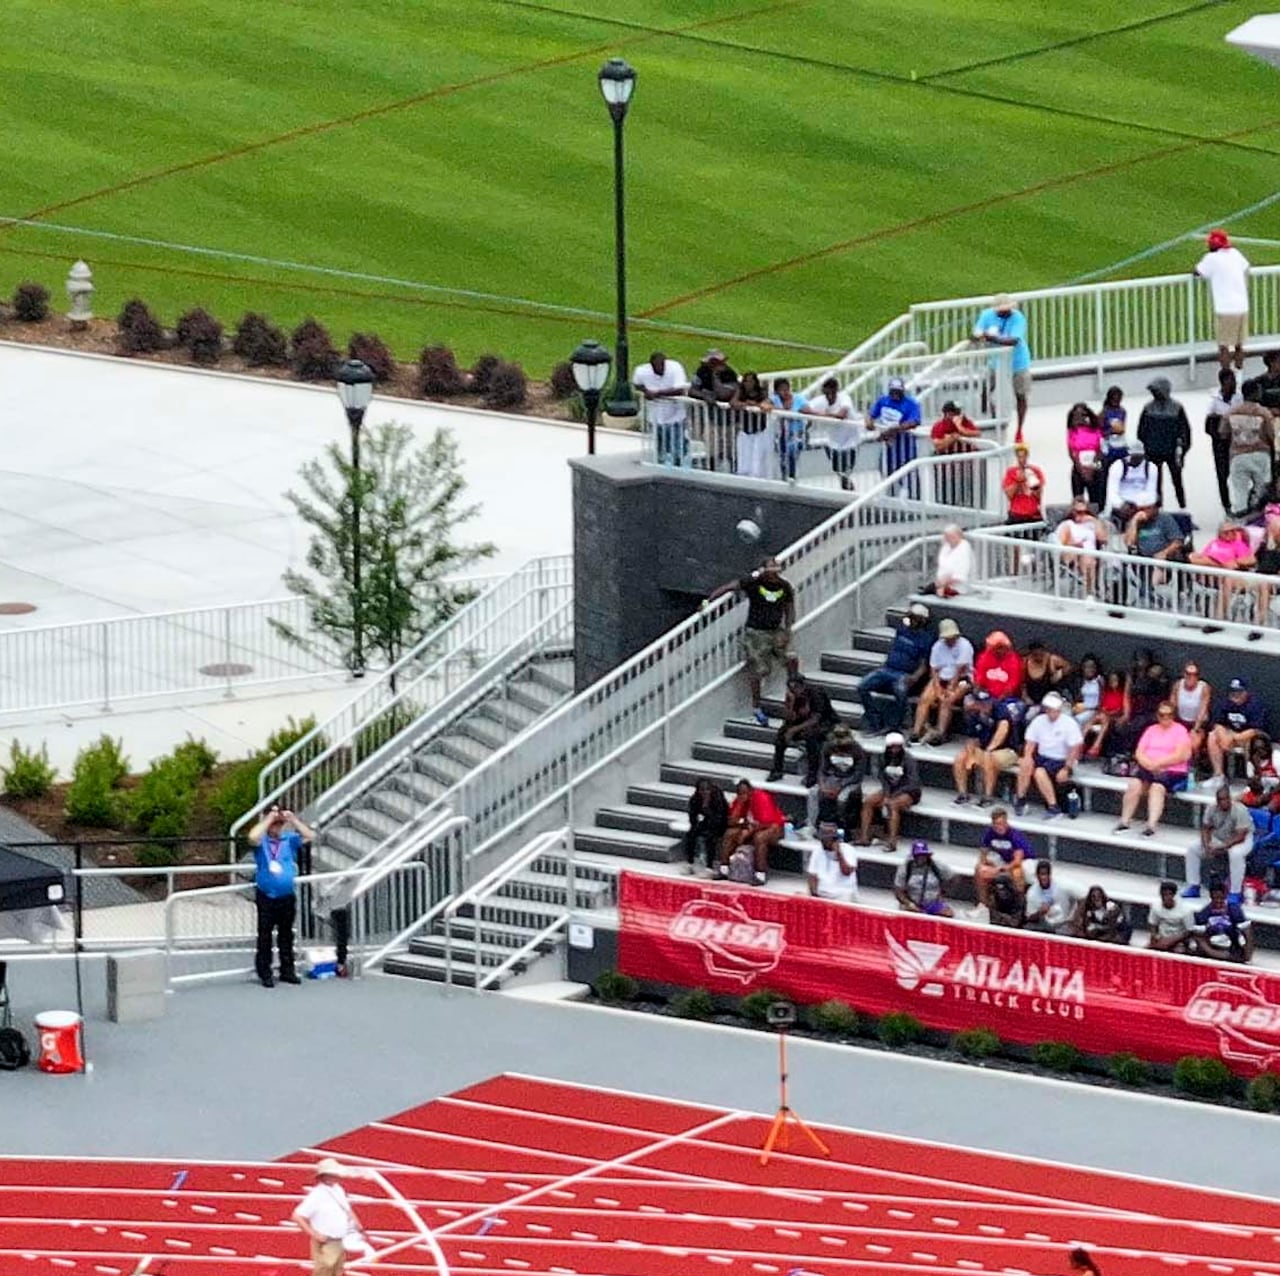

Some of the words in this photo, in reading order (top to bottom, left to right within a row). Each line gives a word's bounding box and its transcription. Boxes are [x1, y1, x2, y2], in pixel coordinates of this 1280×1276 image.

[671, 914, 782, 949] GHSA
[954, 953, 1085, 1000] ATLANTA
[954, 986, 1019, 1009] TRACK
[1033, 998, 1085, 1019] CLUB
